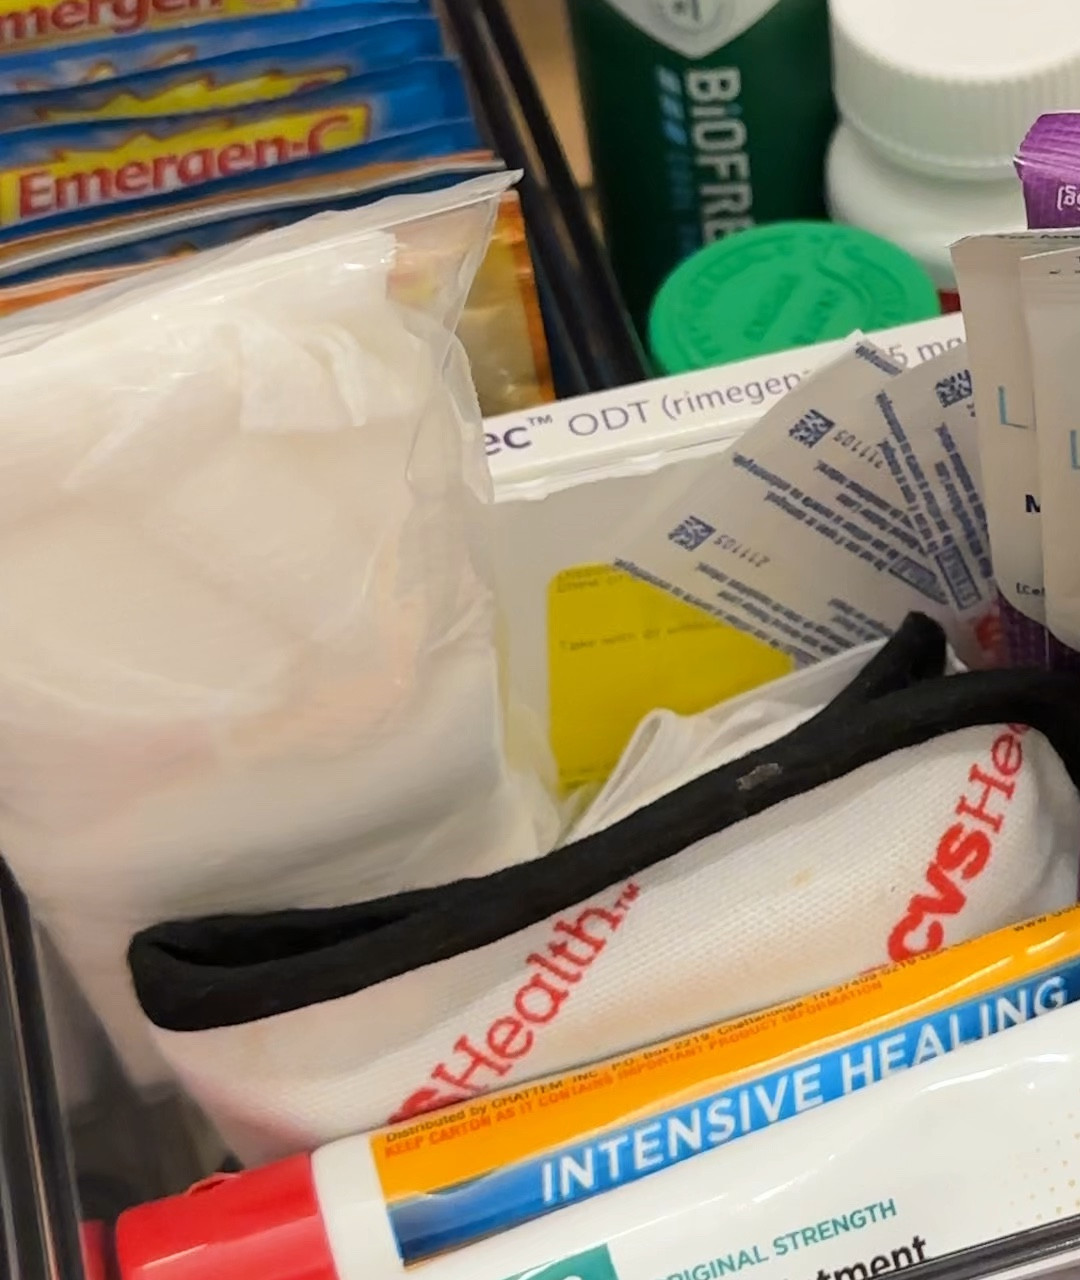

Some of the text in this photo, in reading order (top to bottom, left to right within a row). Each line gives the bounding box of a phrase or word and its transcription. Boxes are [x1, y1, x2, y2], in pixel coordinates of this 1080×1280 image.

[568, 399, 650, 437] ODT
[540, 976, 1069, 1205] INTENSIVE HEALING
[384, 1109, 467, 1143] Distributed
[469, 1104, 487, 1117] by
[427, 1113, 492, 1144] CARTON
[772, 1197, 897, 1258] STRENGTH
